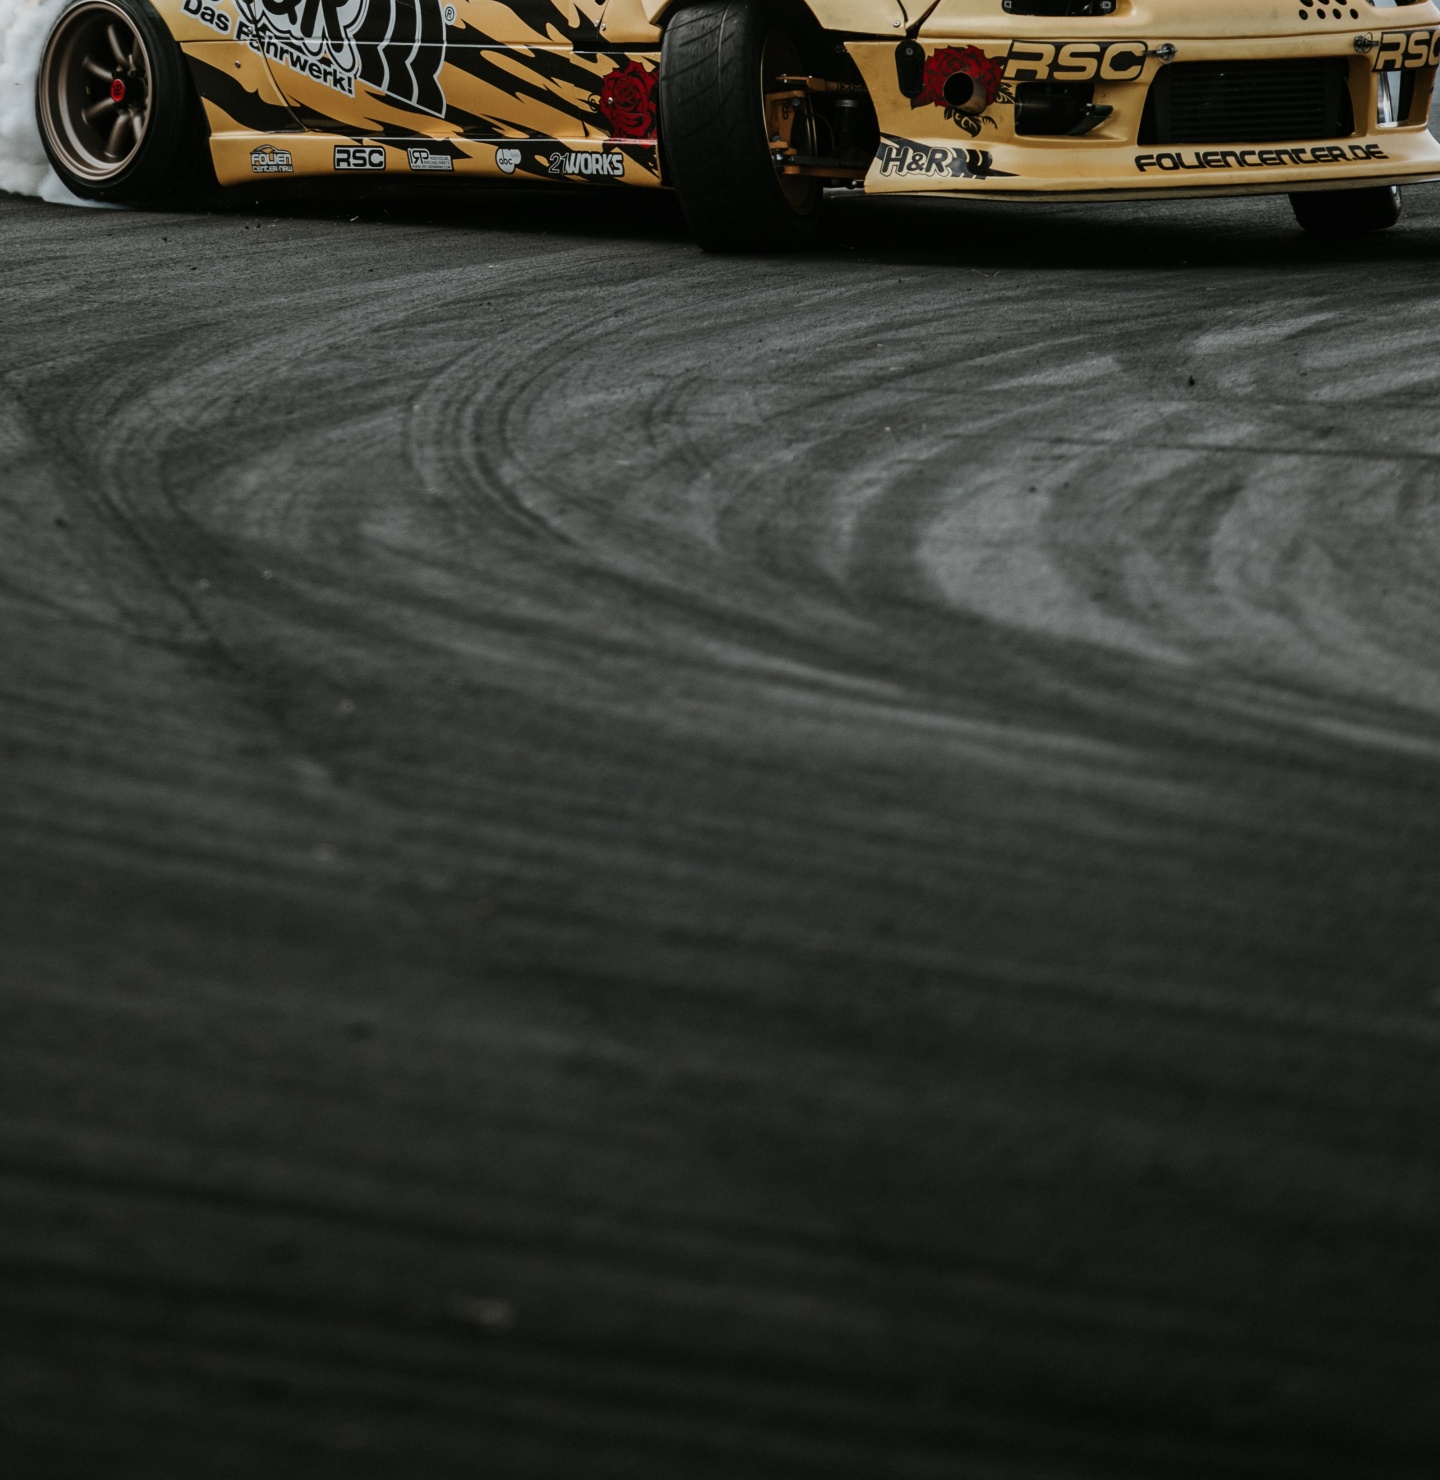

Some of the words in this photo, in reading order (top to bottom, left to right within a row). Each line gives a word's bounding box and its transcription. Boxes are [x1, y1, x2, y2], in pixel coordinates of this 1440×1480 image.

[236, 20, 355, 96] Fahrwerk!
[1003, 41, 1145, 81] RSC
[251, 153, 292, 165] FOLIEN
[336, 149, 384, 168] RSC
[499, 149, 514, 165] abc
[548, 152, 623, 176] 21WORKS
[880, 146, 953, 177] H&R
[1134, 143, 1389, 172] FOLIENCENTER.DE
